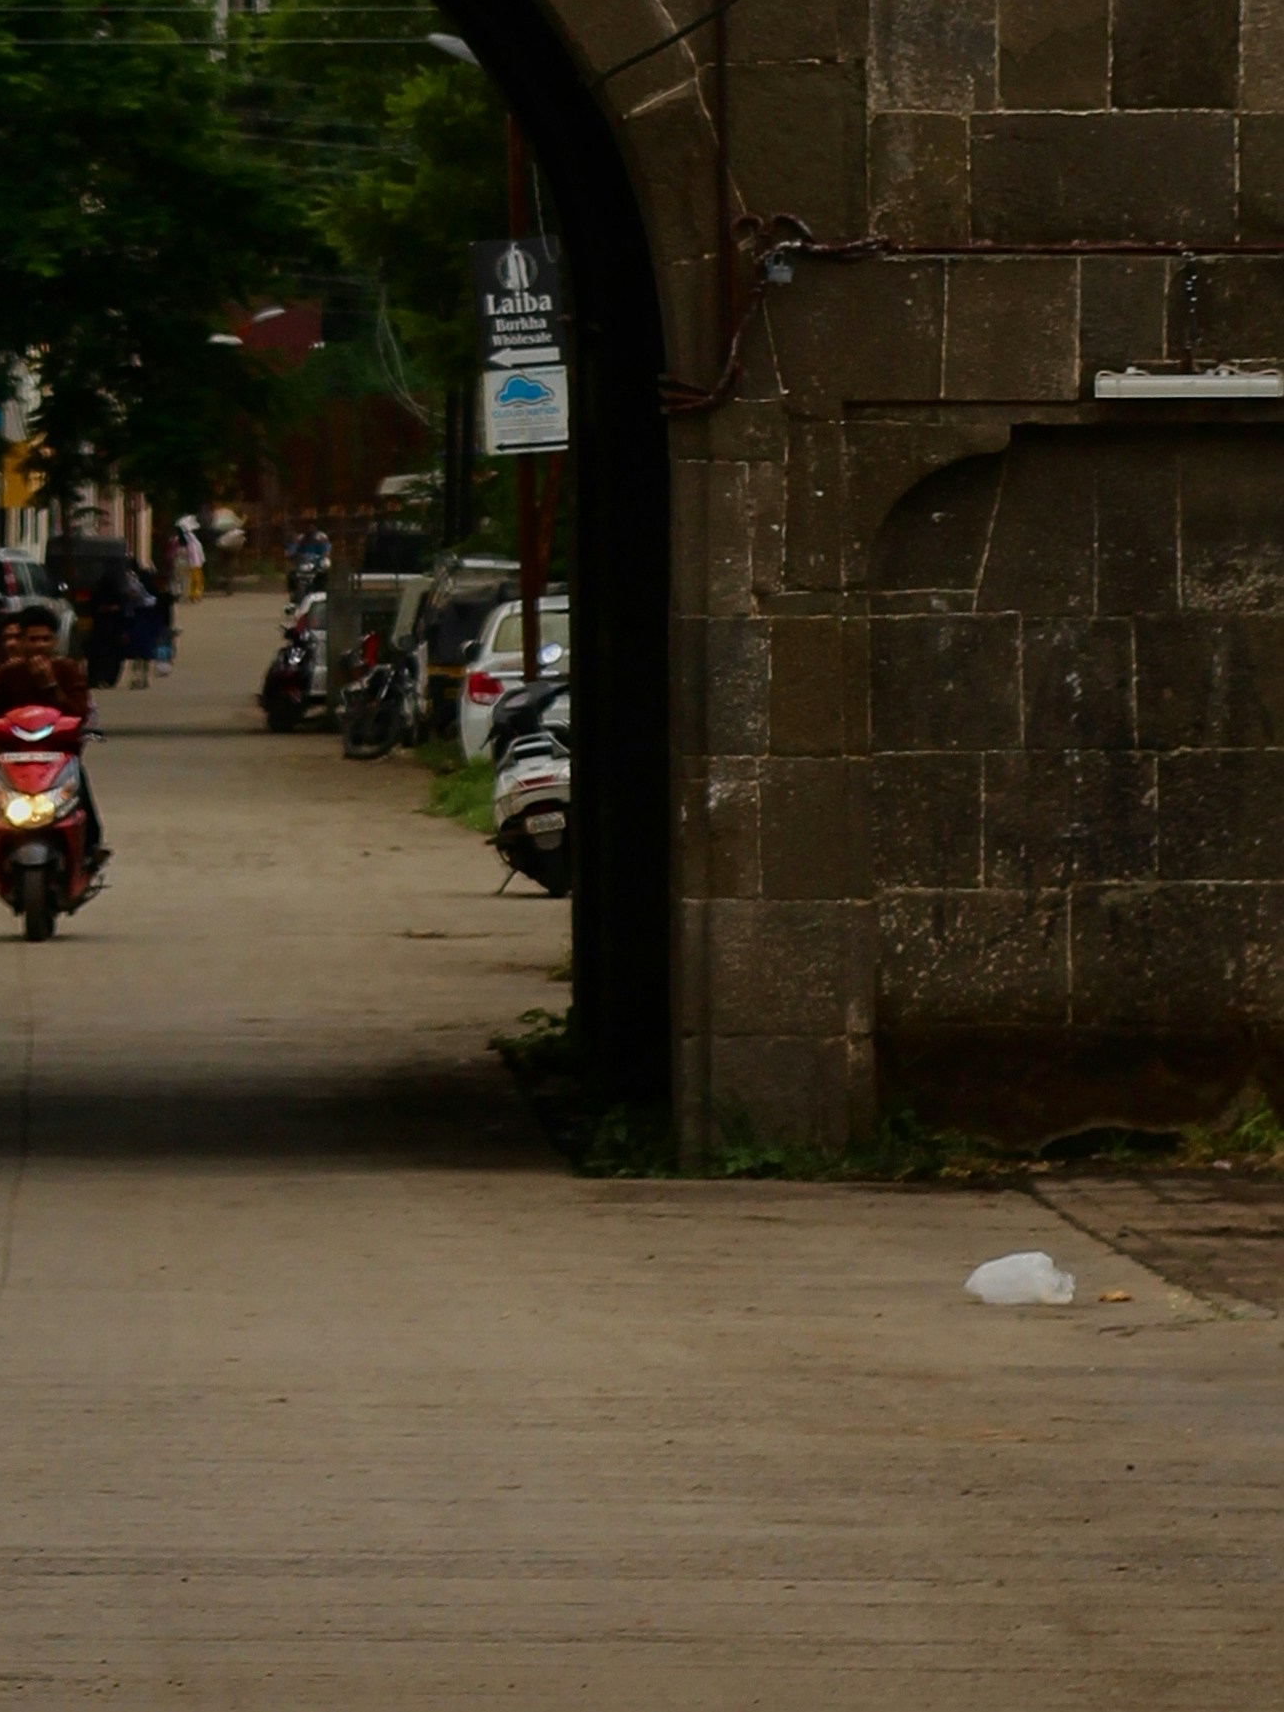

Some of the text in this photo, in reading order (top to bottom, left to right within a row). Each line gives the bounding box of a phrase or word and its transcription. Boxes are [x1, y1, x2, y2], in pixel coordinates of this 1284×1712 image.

[486, 291, 553, 316] Laiba
[496, 316, 547, 332] Burkha
[492, 332, 552, 347] Wholesale
